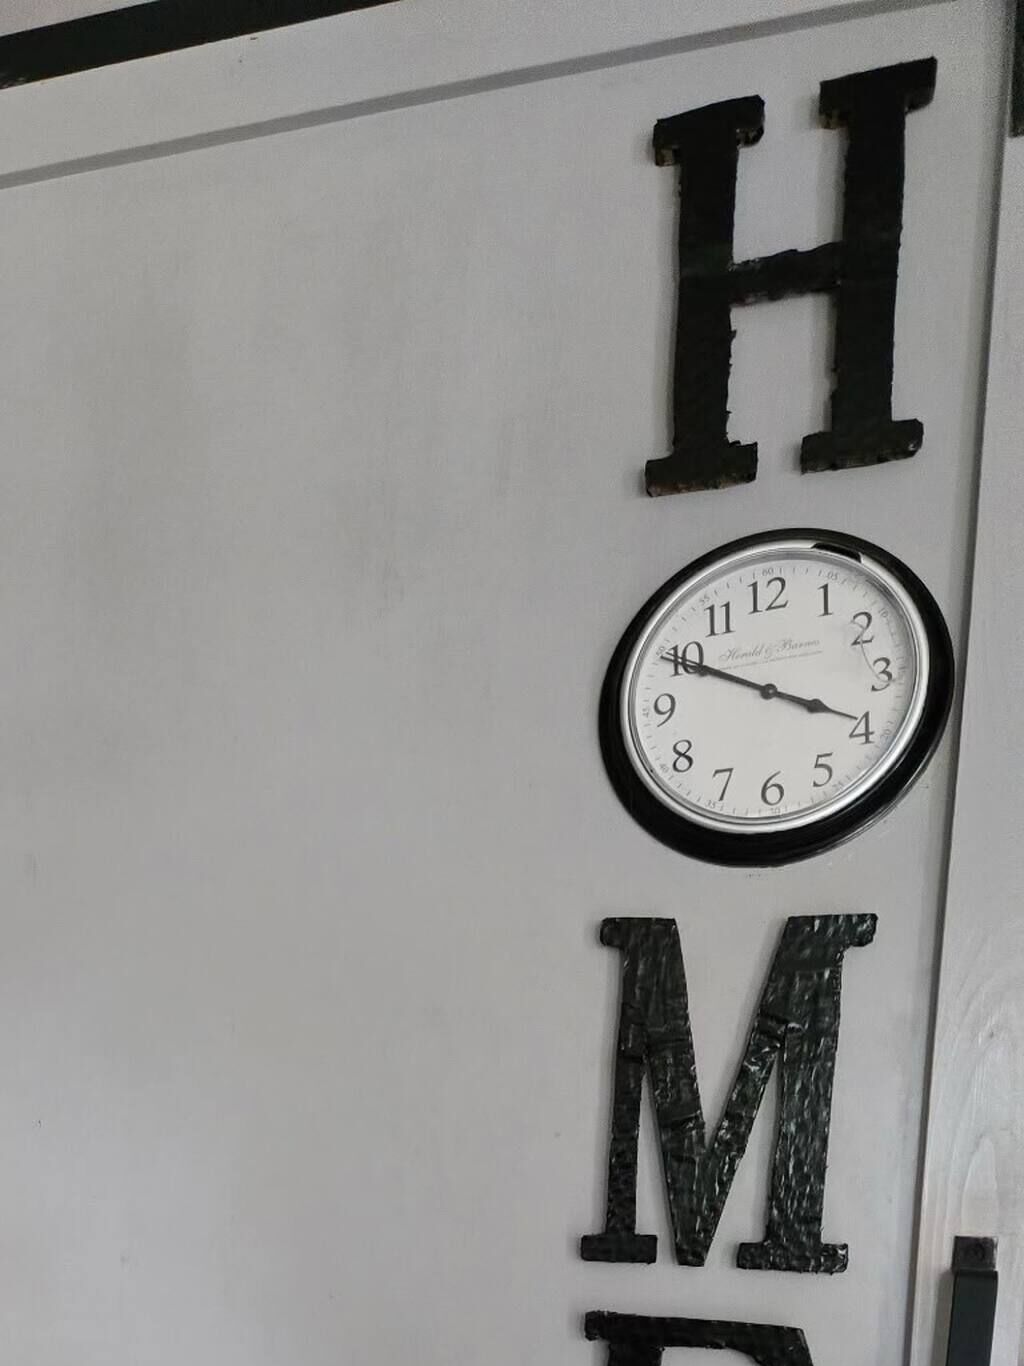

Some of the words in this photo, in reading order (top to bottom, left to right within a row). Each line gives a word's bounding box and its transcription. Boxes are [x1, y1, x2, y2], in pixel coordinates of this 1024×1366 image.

[747, 577, 789, 615] 12
[817, 583, 834, 617] 1
[703, 600, 736, 638] 11
[850, 611, 875, 646] 2
[668, 641, 705, 678] 10
[871, 656, 894, 692] 3
[653, 692, 676, 728] 9
[848, 710, 875, 745] 4
[672, 739, 694, 773] 8
[812, 751, 834, 788] 5
[711, 767, 734, 802] 7
[760, 770, 785, 806] 6
